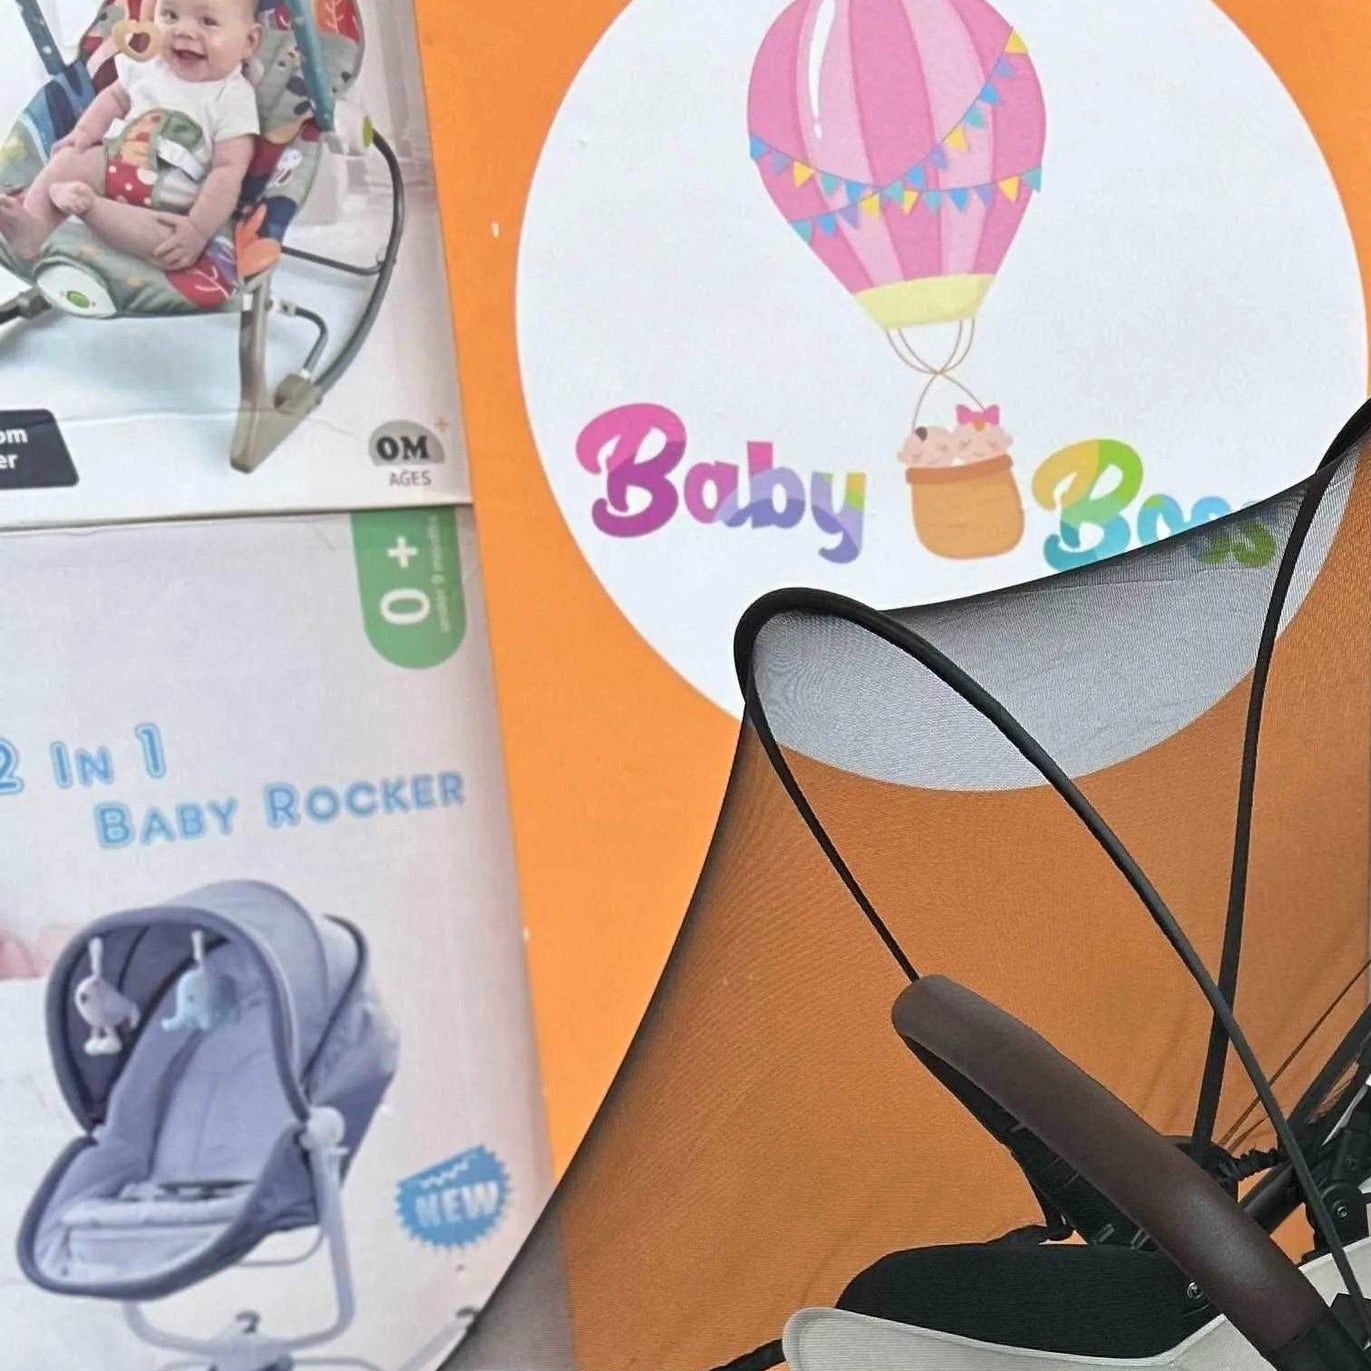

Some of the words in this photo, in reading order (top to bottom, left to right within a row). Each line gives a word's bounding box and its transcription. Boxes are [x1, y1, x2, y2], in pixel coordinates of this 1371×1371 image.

[390, 470, 432, 486] AGES
[575, 403, 867, 565] Baby
[134, 723, 166, 779] 1
[414, 1179, 499, 1229] NEW
